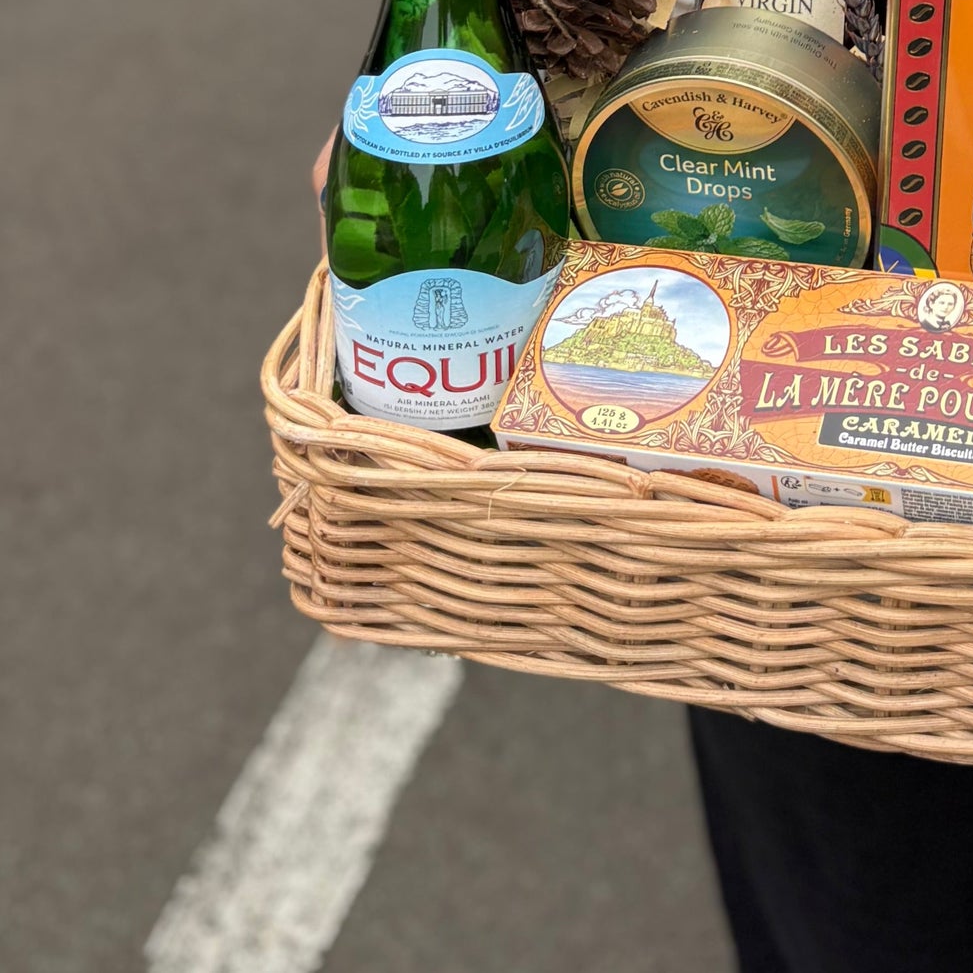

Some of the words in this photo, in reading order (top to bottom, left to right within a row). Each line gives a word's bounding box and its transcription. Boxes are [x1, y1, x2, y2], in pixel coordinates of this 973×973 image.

[754, 16, 793, 34] Germany
[754, 26, 768, 35] the
[770, 30, 788, 42] with
[803, 34, 826, 50] Made
[790, 38, 822, 58] Original
[824, 56, 838, 70] The
[641, 90, 712, 113] Cavendish
[716, 93, 728, 104] &
[732, 96, 782, 124] Harvey
[390, 148, 420, 158] BOTTLED
[432, 150, 462, 158] SOURCE
[463, 148, 473, 156] AT
[474, 144, 493, 154] VILLA
[659, 153, 717, 176] Clear
[723, 159, 776, 182] Mint
[610, 172, 639, 186] natural
[687, 178, 752, 202] Drops
[843, 207, 852, 237] Germany
[366, 334, 417, 351] NATURAL
[423, 340, 479, 351] MINERAL
[485, 326, 524, 344] WATER
[824, 334, 888, 355] LES
[461, 394, 490, 405] ALAMI
[755, 371, 804, 409] LA
[811, 372, 908, 410] MÈRE
[394, 406, 422, 415] BERSIH
[447, 406, 479, 414] WEIGHT
[597, 407, 615, 419] 125
[838, 432, 888, 450] Caramel
[890, 439, 929, 455] Butter
